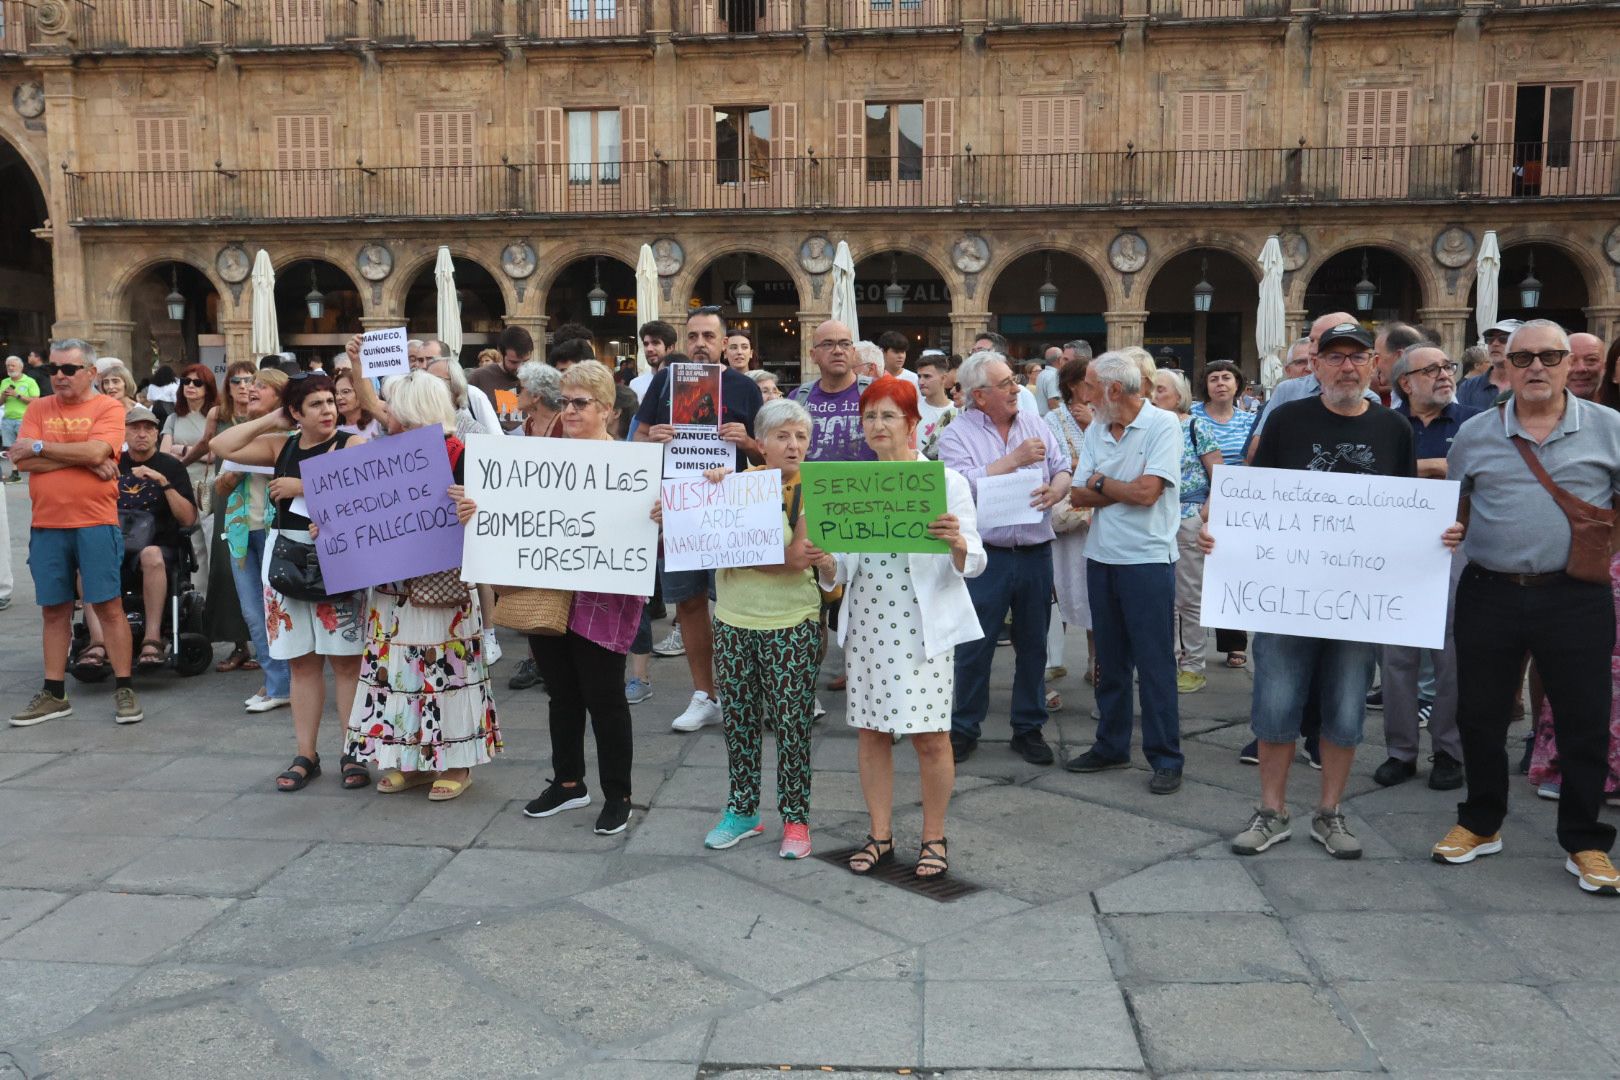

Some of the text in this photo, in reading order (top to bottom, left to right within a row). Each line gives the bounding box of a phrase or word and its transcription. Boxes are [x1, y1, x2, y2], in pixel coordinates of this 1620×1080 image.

[841, 400, 860, 412] in
[670, 445, 730, 457] QUIÑONES,
[311, 448, 430, 495] LAMENTAMOS
[478, 458, 648, 493] YO APOYO A L@S
[316, 483, 431, 525] LA PERDIDA DE
[662, 479, 726, 512] NUESTRA
[822, 500, 931, 516] FORESTALES
[1220, 478, 1266, 501] Cada
[1347, 484, 1436, 511] calcinada
[324, 502, 460, 556] LOS FALLECIDOS
[476, 509, 597, 538] BOMBER@S
[700, 507, 745, 529] ARDE
[1226, 512, 1356, 532] LLEVA LA FIRMA
[518, 545, 648, 572] FORESTALES
[1256, 545, 1275, 560] DE
[1287, 549, 1310, 565] UN
[1221, 580, 1406, 622] NEGLIGENTE
